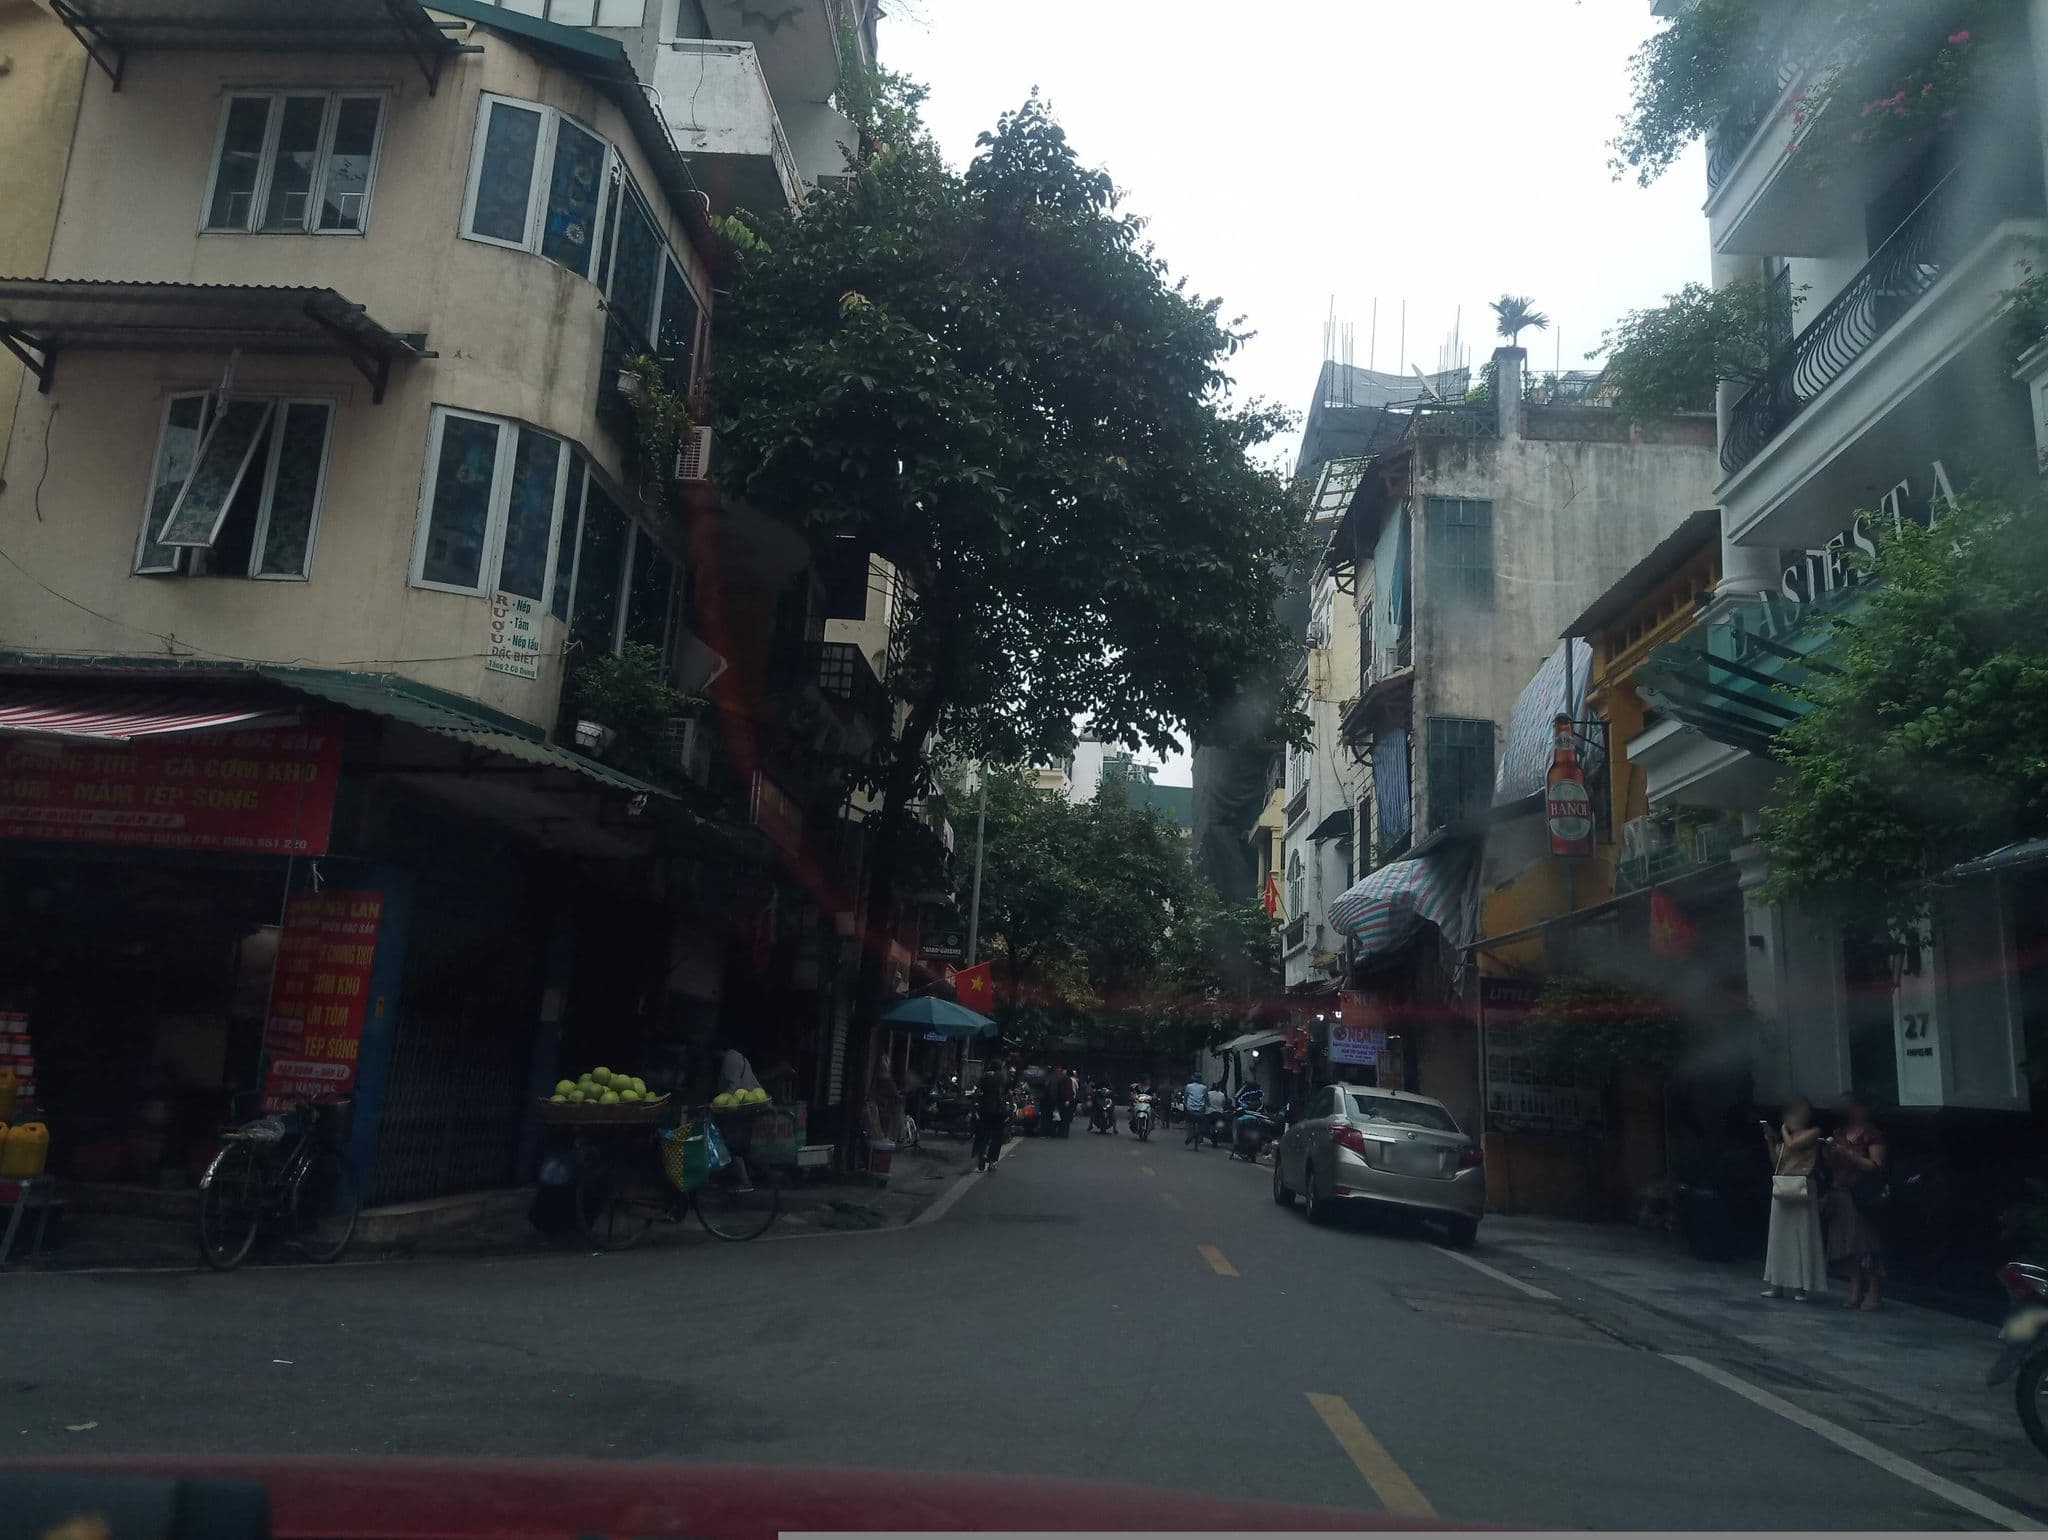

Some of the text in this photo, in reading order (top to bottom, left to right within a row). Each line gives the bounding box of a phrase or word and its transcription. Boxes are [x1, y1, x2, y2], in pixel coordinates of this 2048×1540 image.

[504, 663, 509, 671] 2
[1550, 803, 1589, 817] HANOI
[351, 903, 380, 918] LAN
[1902, 1012, 1930, 1040] 27
